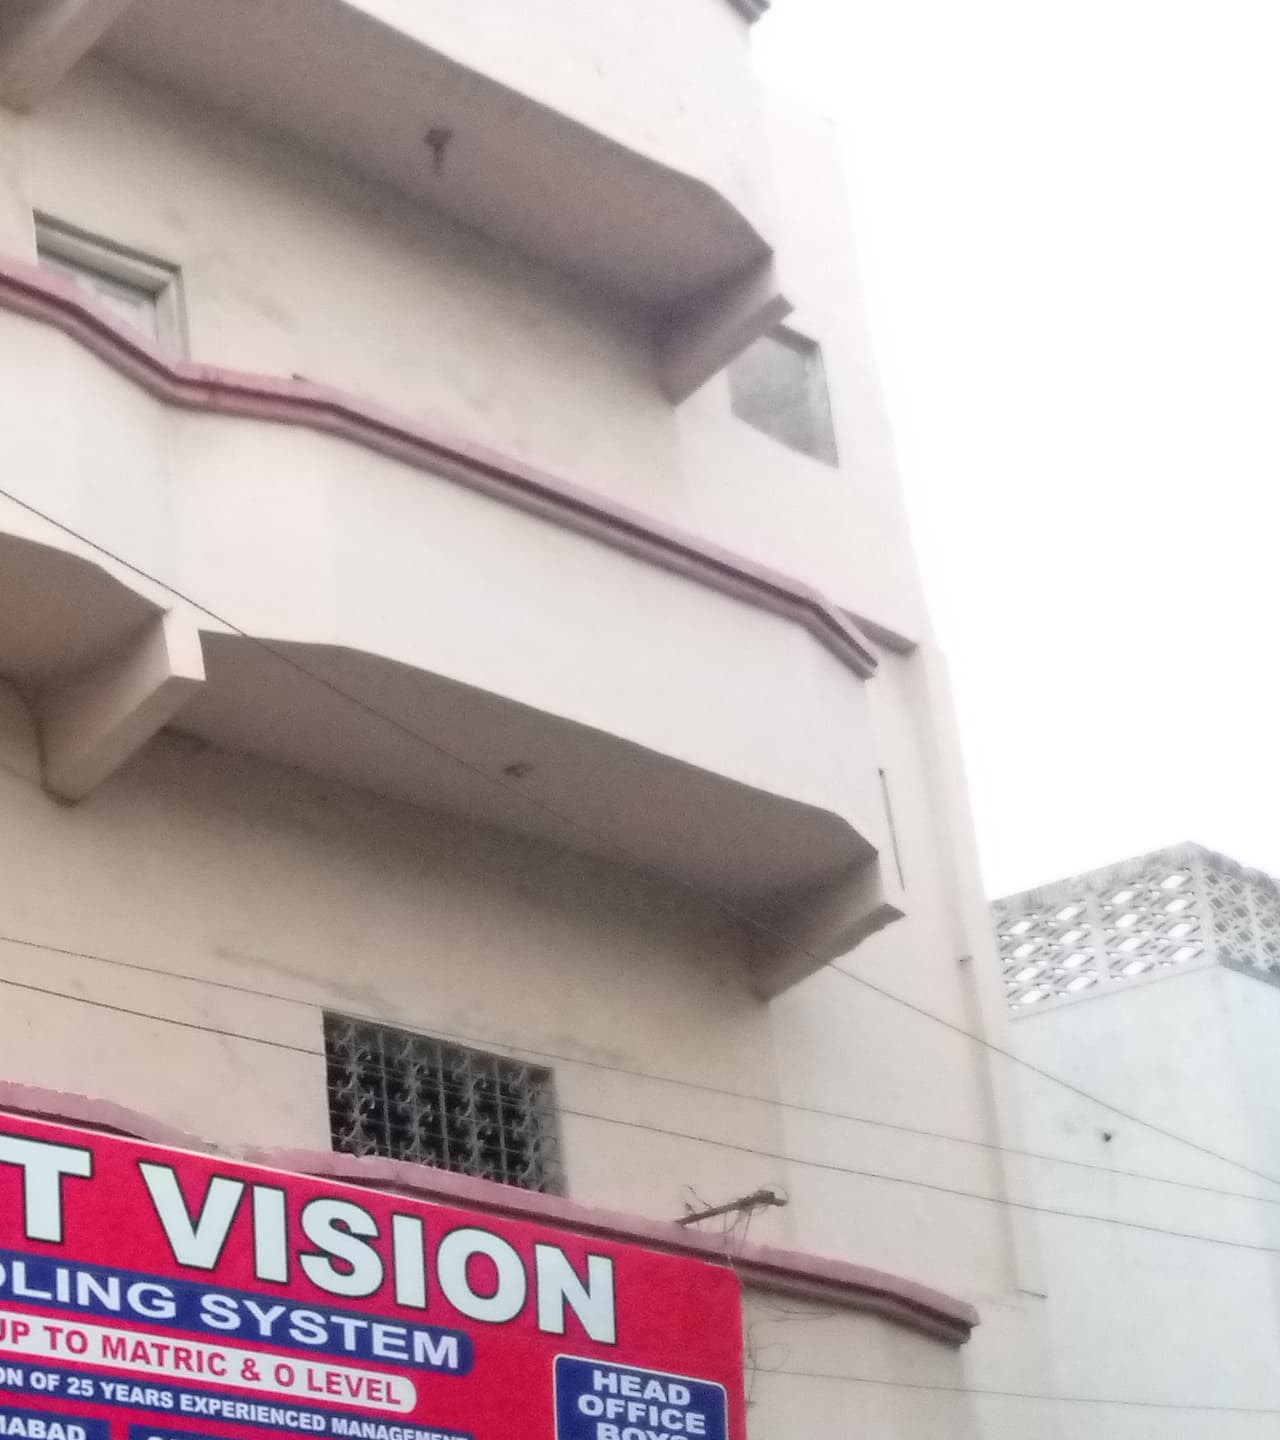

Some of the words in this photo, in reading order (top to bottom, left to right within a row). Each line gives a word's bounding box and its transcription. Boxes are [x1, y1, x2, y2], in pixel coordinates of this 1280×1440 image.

[139, 1162, 617, 1345] VISION
[44, 1325, 88, 1354] TO
[102, 1335, 227, 1376] MATRIC
[241, 1358, 261, 1382] &
[274, 1363, 295, 1387] O
[307, 1367, 402, 1406] LEVEL
[200, 1293, 459, 1369] SYSTEM
[29, 1370, 61, 1392] OF
[66, 1375, 94, 1397] 25
[101, 1383, 174, 1410] YEARS
[180, 1394, 327, 1432] EXPERIENCED
[578, 1394, 706, 1435] OFFICE
[593, 1370, 690, 1406] HEAD
